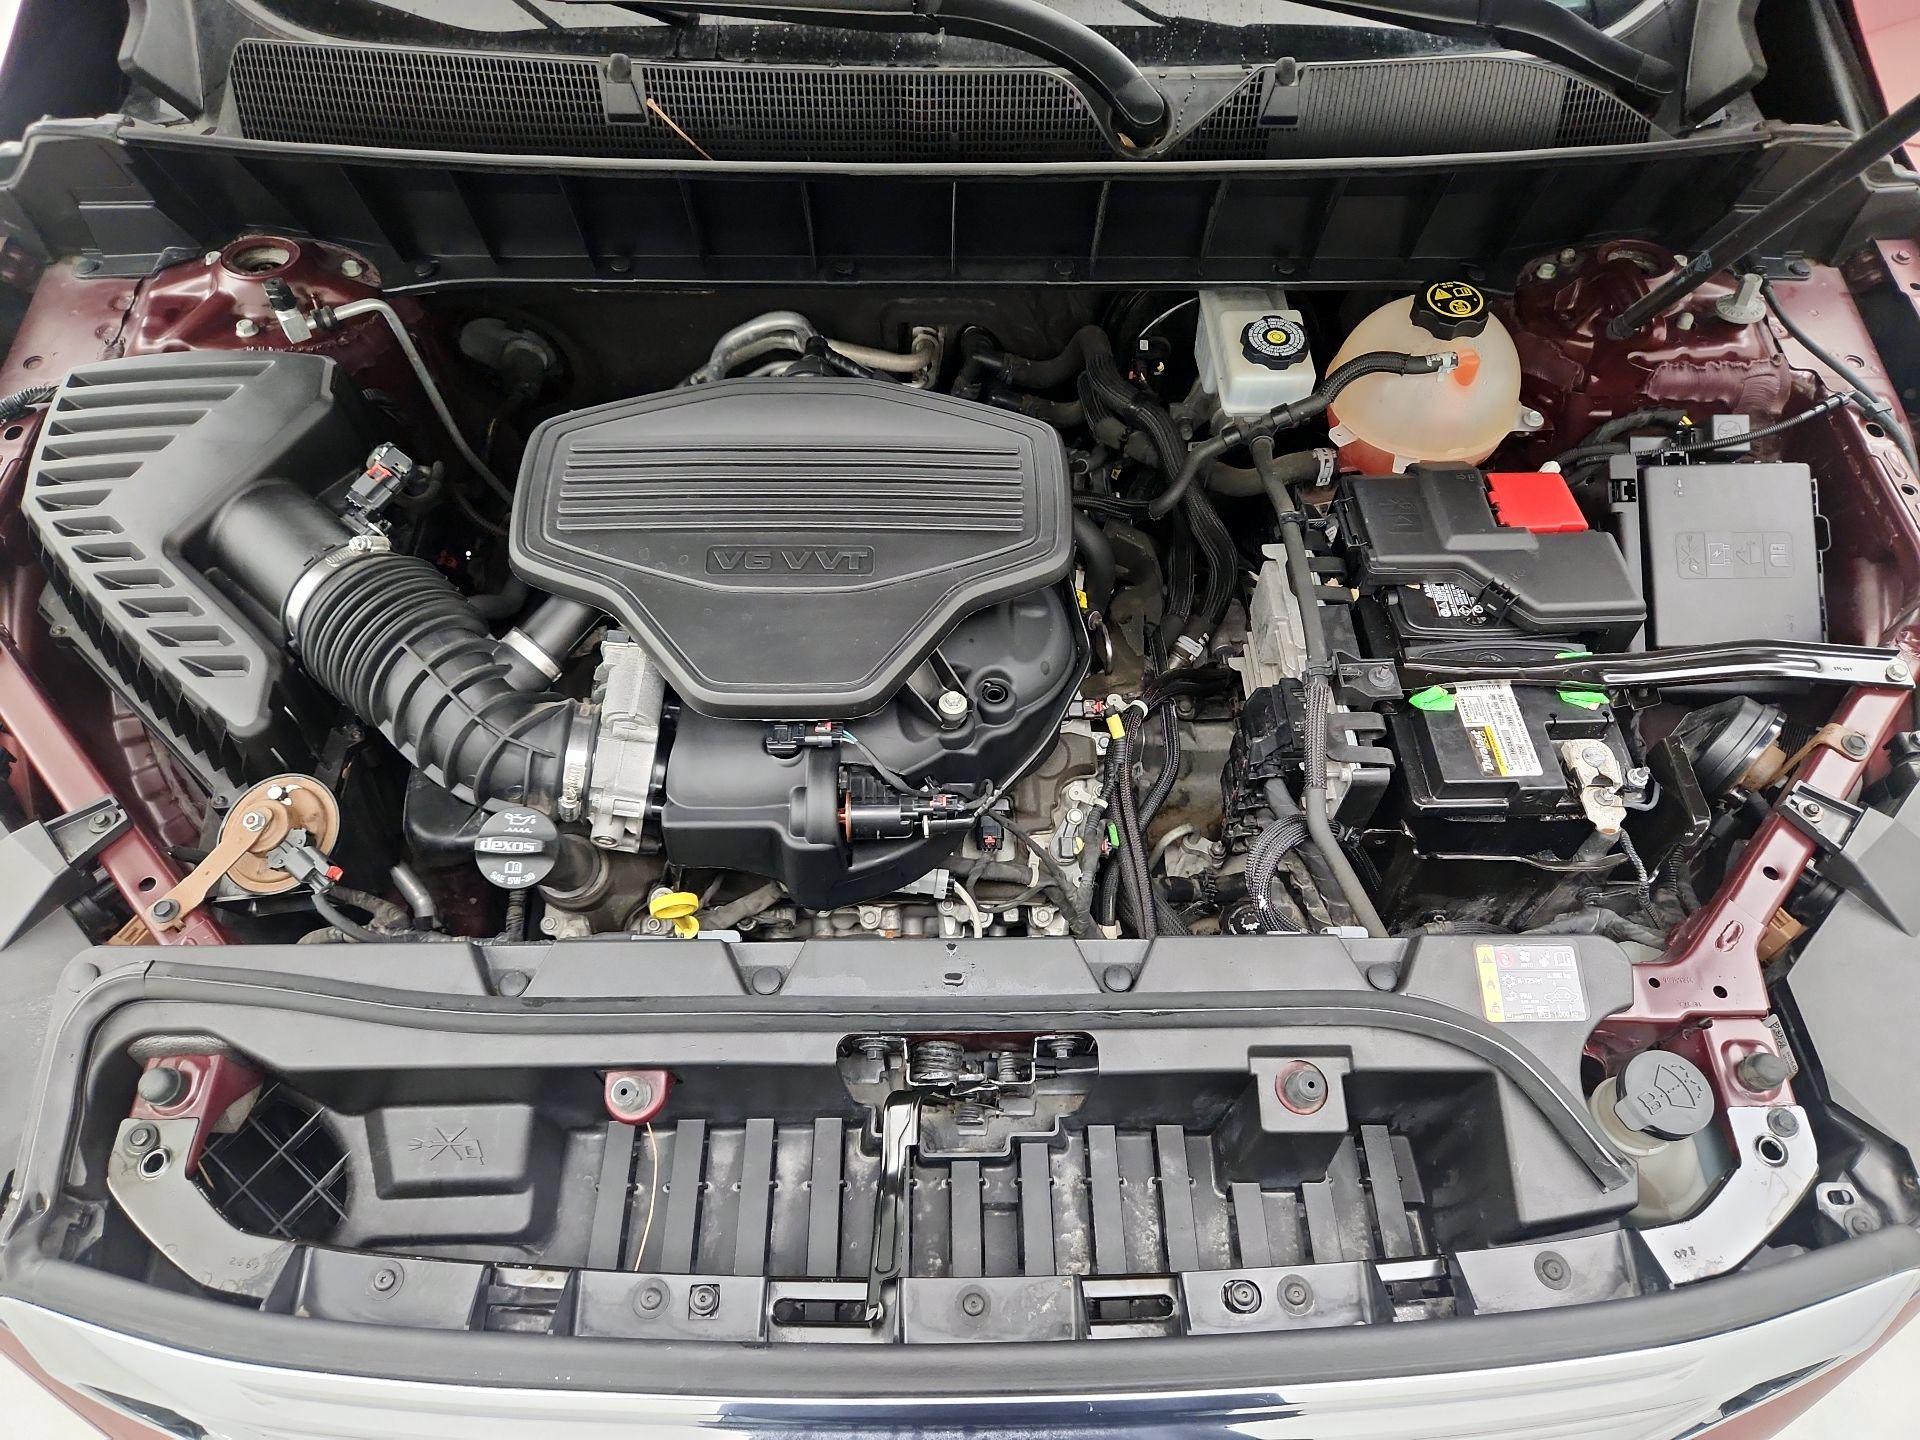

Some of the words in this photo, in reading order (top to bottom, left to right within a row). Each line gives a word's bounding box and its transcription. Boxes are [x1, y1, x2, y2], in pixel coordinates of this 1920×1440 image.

[713, 551, 773, 570] V6
[781, 551, 868, 570] VVT
[1471, 729, 1495, 772] Duralast
[479, 838, 537, 852] dexos
[490, 871, 505, 882] SAE
[507, 872, 536, 885] 5W-30
